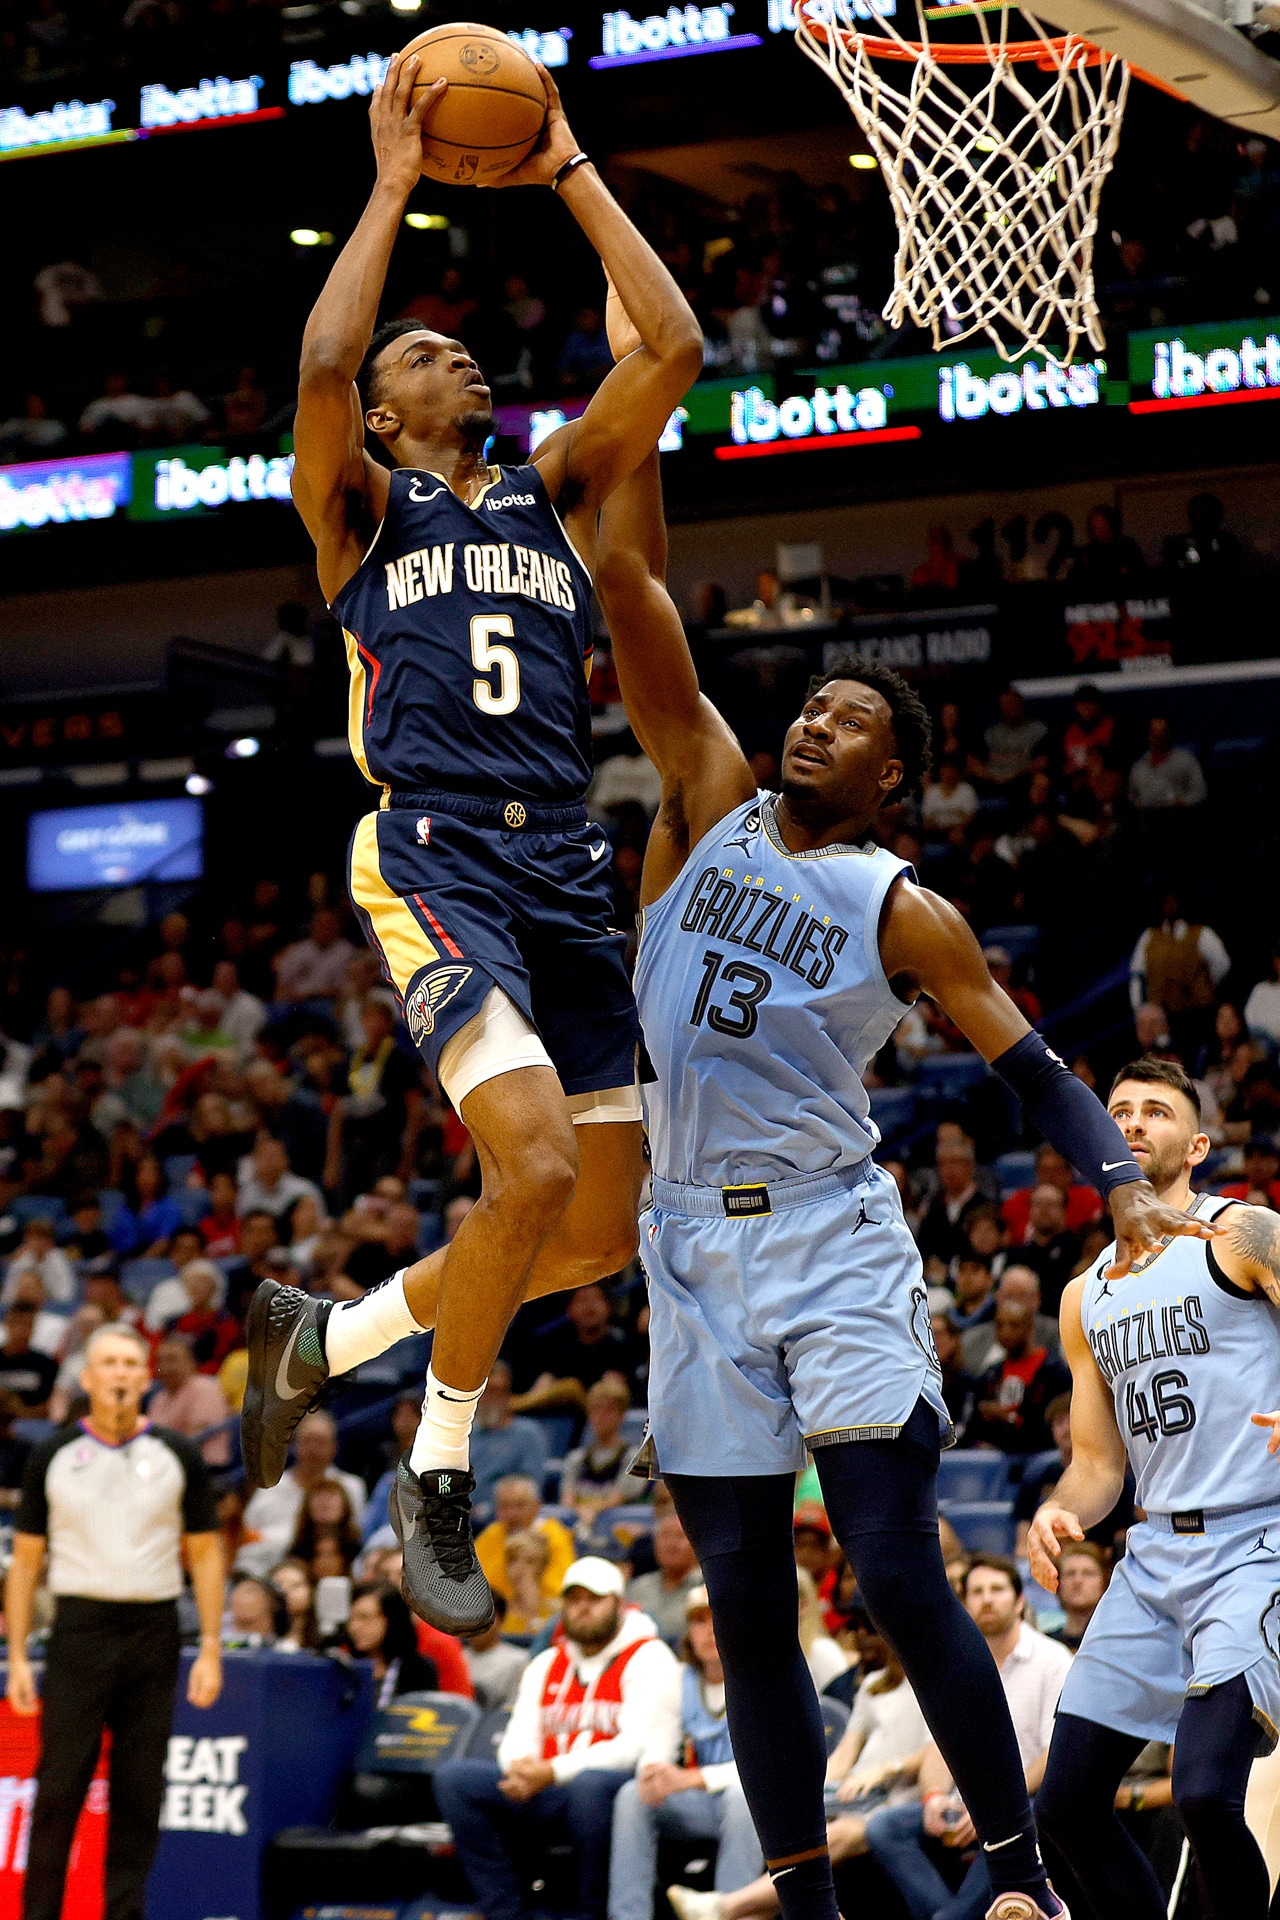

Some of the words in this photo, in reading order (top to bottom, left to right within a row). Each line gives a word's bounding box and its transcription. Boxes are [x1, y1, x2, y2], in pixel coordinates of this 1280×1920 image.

[602, 5, 723, 56] ibotta
[140, 77, 260, 128] ibotta
[288, 52, 392, 106] ibott
[938, 362, 1101, 421] ibotta
[1152, 334, 1280, 399] ibott
[730, 386, 887, 445] ibotta
[485, 491, 536, 511] ibotta
[384, 543, 455, 612] NEW
[463, 543, 576, 612] ORLEANS
[469, 614, 521, 716] 5
[721, 867, 832, 926] MEMPHIS
[680, 866, 850, 990] GRIZZLIES
[689, 949, 772, 1040] 13
[1089, 1296, 1211, 1384] GRIZZLIES
[1126, 1368, 1197, 1444] 46
[163, 1735, 248, 1784] EAT
[158, 1785, 248, 1837] EEK
